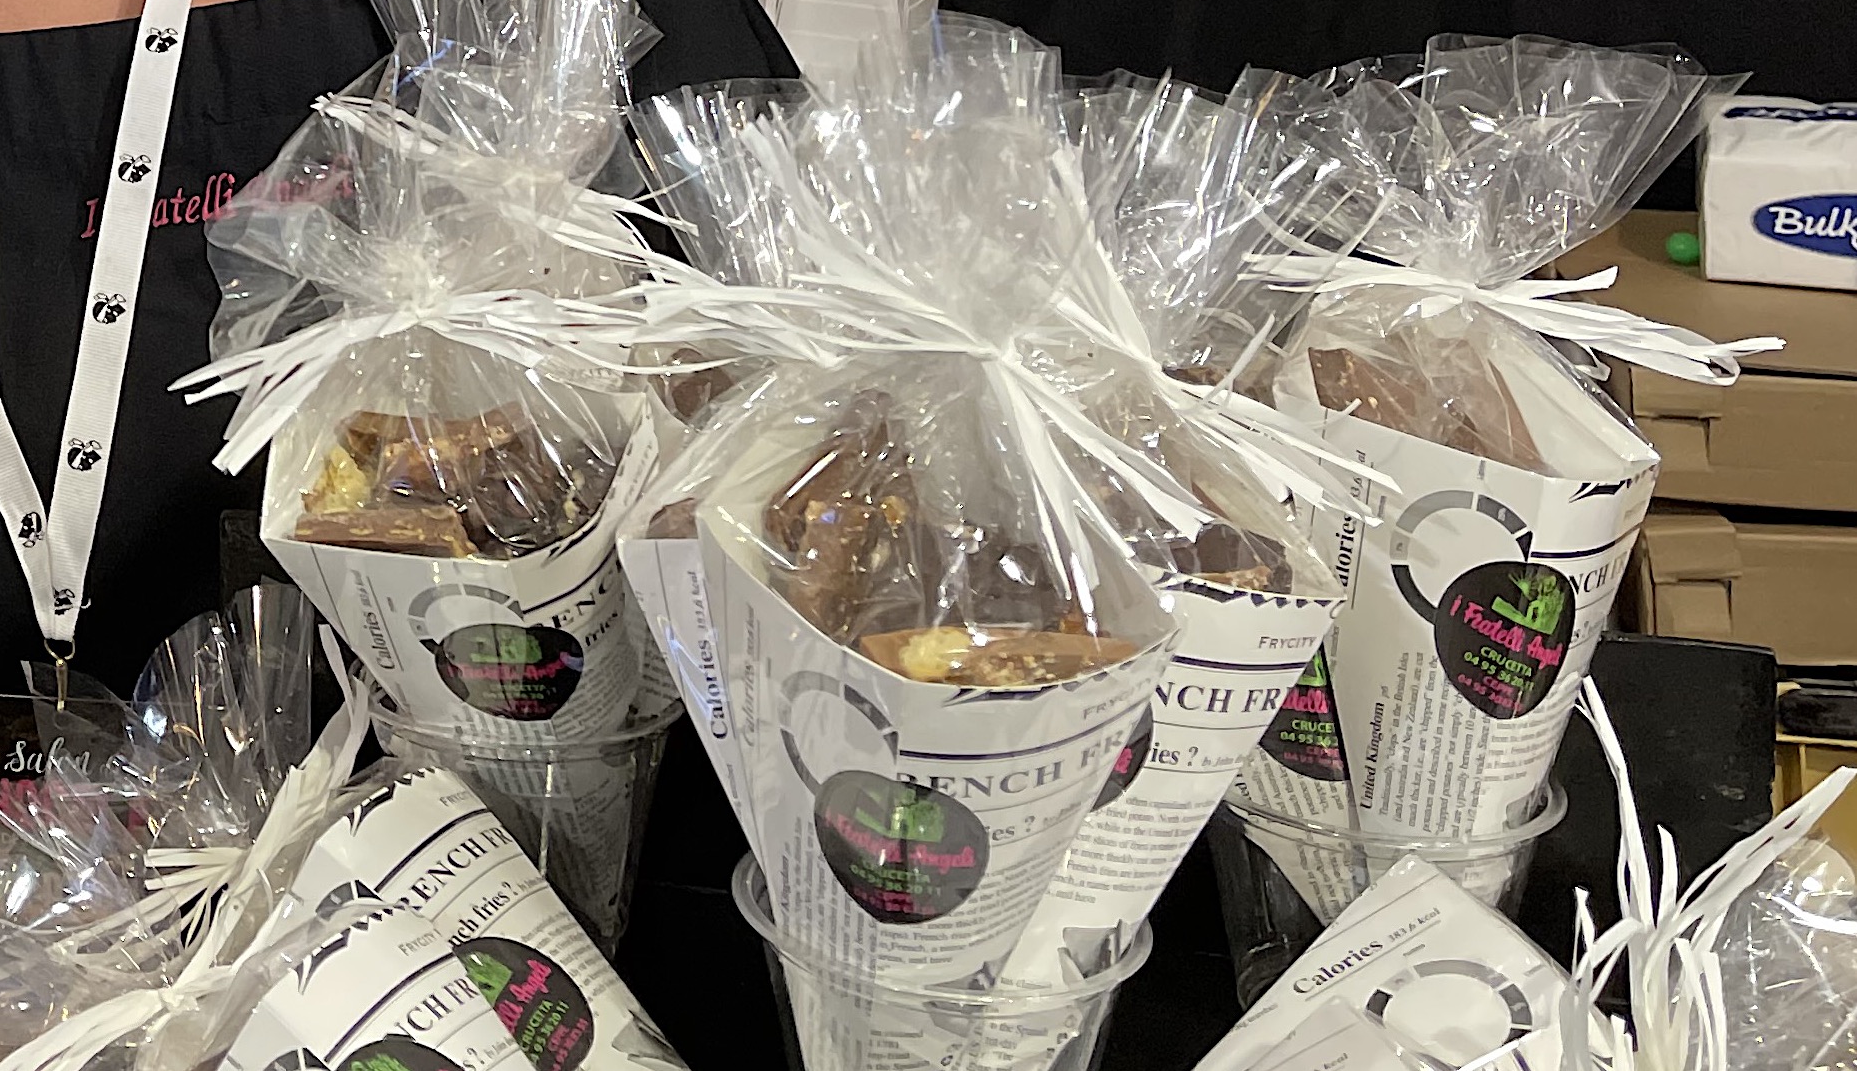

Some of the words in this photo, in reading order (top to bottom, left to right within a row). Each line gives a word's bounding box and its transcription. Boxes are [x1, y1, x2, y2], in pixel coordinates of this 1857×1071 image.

[152, 173, 236, 227] atelli
[1336, 513, 1357, 587] alories
[1569, 563, 1609, 596] NCH
[362, 611, 395, 670] Calories
[1258, 636, 1318, 650] FRYCITY
[1464, 651, 1479, 665] 04
[1480, 646, 1532, 677] CRUCETTA
[699, 639, 728, 740] Calories
[1155, 681, 1234, 713] NCH
[1292, 719, 1335, 733] CRUCE
[1366, 702, 1384, 763] Kingdom
[4, 737, 90, 774] Salon
[1149, 742, 1180, 766] ies
[1360, 765, 1378, 809] United
[399, 837, 488, 911] RENCH
[448, 917, 480, 947] nch
[472, 888, 511, 922] fries
[1292, 938, 1384, 994] Calories
[1417, 907, 1441, 925] kcal
[393, 993, 451, 1043] NCH
[520, 998, 553, 1052] CRUCETTA
[528, 1052, 540, 1065] 4
